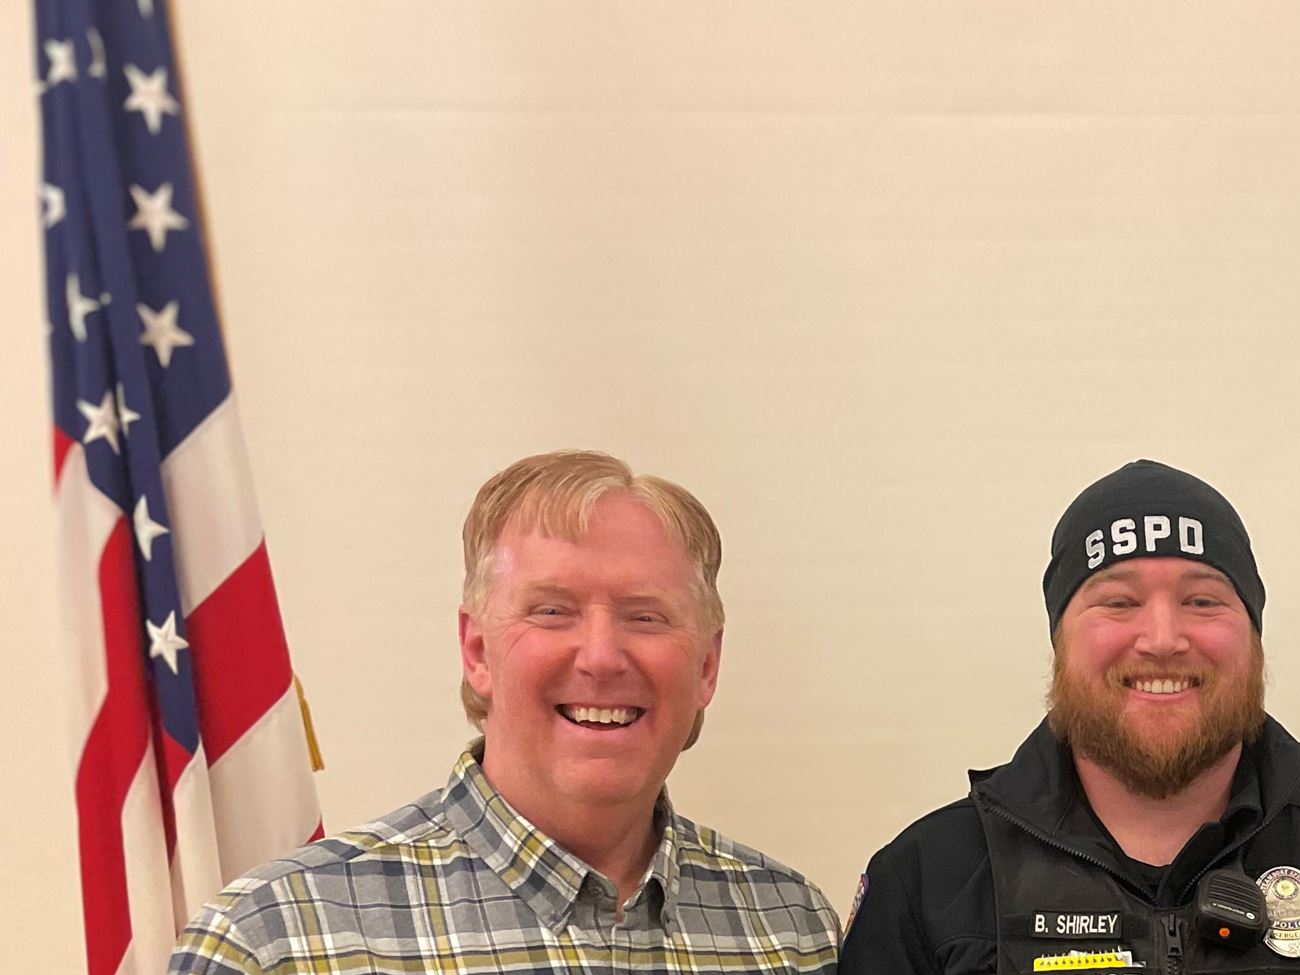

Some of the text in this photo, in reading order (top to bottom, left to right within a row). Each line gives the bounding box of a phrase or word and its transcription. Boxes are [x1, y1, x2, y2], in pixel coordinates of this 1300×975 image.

[1085, 515, 1205, 570] SSPD
[1034, 914, 1118, 934] B. SHIRLEY
